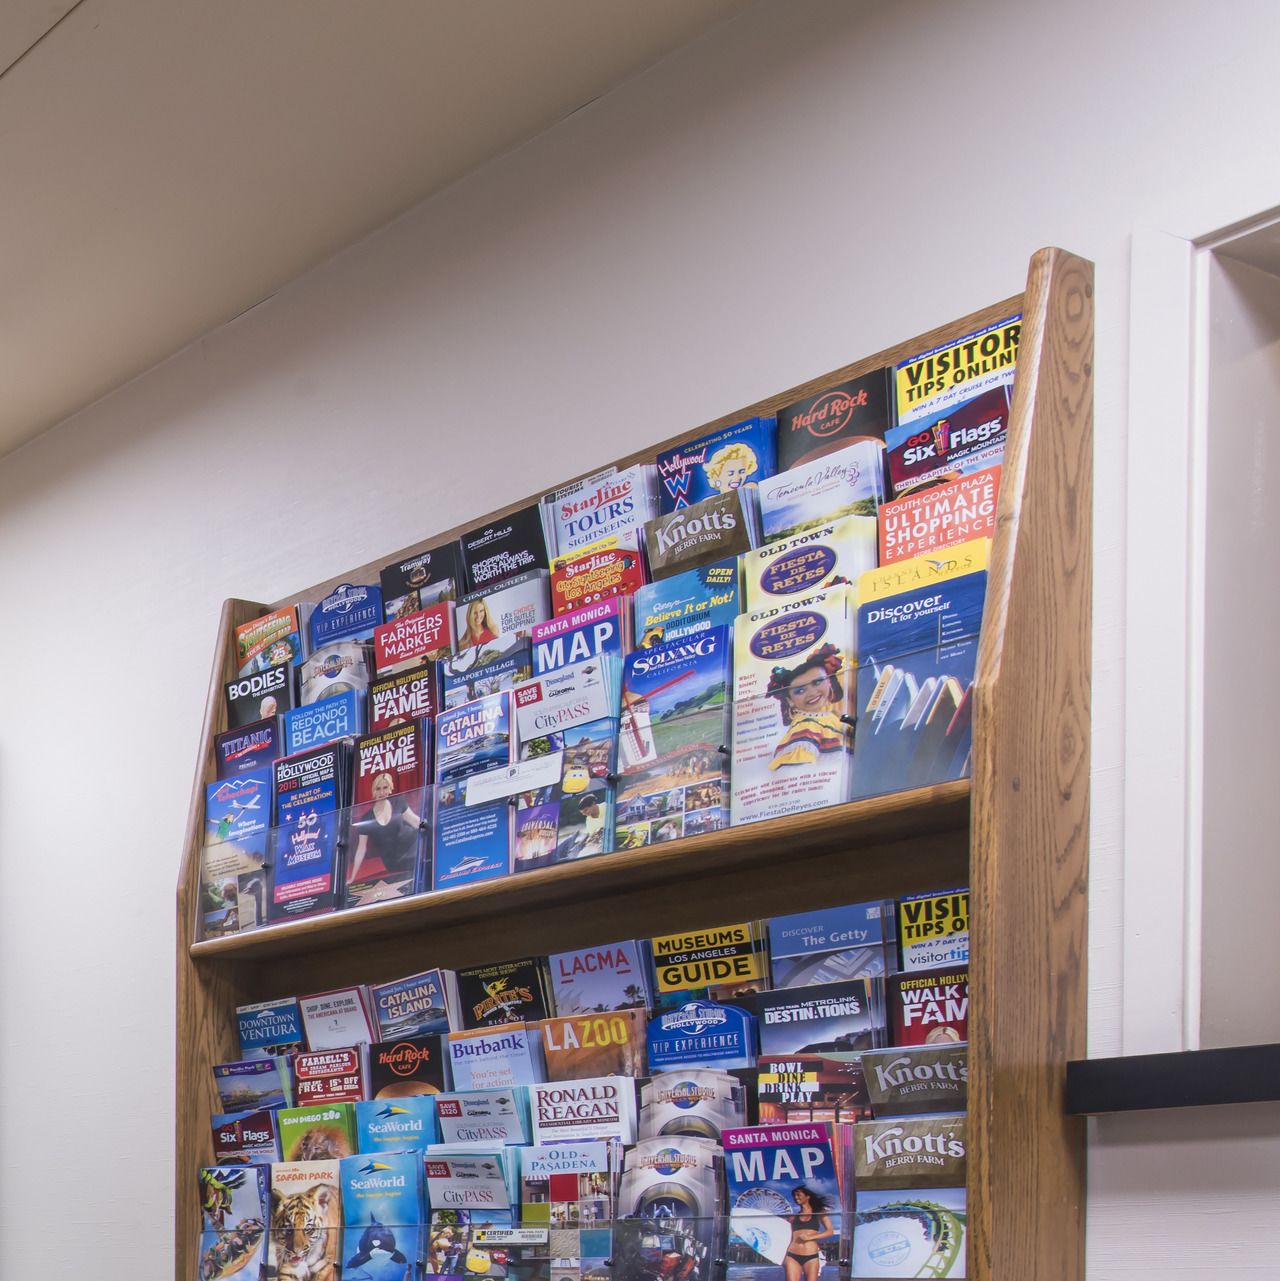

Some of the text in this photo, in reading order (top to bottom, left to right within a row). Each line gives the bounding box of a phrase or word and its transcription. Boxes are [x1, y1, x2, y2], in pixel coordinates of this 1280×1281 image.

[906, 346, 1019, 402] TIPS ONLIN
[885, 474, 993, 516] SOUTH COAST PLAZA
[885, 485, 994, 531] ULTIMATE
[564, 497, 635, 537] TOURS
[654, 507, 737, 555] Knott's
[886, 501, 995, 546] SHOPPING
[568, 515, 635, 549] SIGHTSEEING
[760, 526, 835, 559] OLD TOWN
[886, 517, 994, 560] EXPERIENCE
[709, 568, 733, 577] OPEN
[770, 549, 826, 574] FIESTA
[706, 575, 732, 584] DAILY!
[772, 566, 825, 594] REYES
[537, 605, 611, 637] SANTA MONICA
[665, 610, 711, 630] ODDITORIUM
[750, 592, 826, 623] OLD TOWN
[867, 594, 942, 624] Discover
[380, 615, 443, 647] FARMERS
[759, 615, 817, 640] FIESTA
[385, 631, 440, 658] MARKET
[538, 621, 614, 673] MAP
[632, 636, 716, 677] SOLVANG
[762, 633, 816, 656] REYES
[229, 667, 285, 700] BODIES
[373, 677, 428, 705] WALK OF
[517, 687, 538, 698] SAVE
[291, 705, 347, 732] REDONDO
[373, 692, 429, 722] FAME
[534, 702, 590, 730] CityPASS
[293, 718, 348, 747] BEACH
[441, 706, 503, 737] CATALINA
[446, 722, 496, 747] ISLAND
[222, 727, 272, 755] TITANIC
[360, 747, 415, 777] FAME
[657, 929, 744, 955] MUSEUMS
[669, 946, 736, 964] LOS ANGELES
[559, 949, 629, 978] LACMA
[662, 956, 752, 986] GUIDE
[901, 985, 959, 1004] WALK
[240, 1013, 294, 1031] DOWNTOWN
[764, 1002, 860, 1025] DESTINATIONS
[241, 1024, 296, 1041] VENTURA
[453, 1034, 524, 1059] Burbank
[769, 1062, 803, 1074] BOWL
[537, 1086, 616, 1108] RONALD
[782, 1090, 812, 1103] PLAY
[538, 1101, 618, 1121] REAGAN
[368, 1120, 423, 1134] SeaWorld
[729, 1129, 820, 1145] SANTA MONICA
[864, 1128, 965, 1165] Knott's
[531, 1158, 597, 1171] PASADENA
[731, 1147, 825, 1183] MAP
[885, 1155, 945, 1168] BERRY FARM
[351, 1176, 405, 1190] SeaWorld
